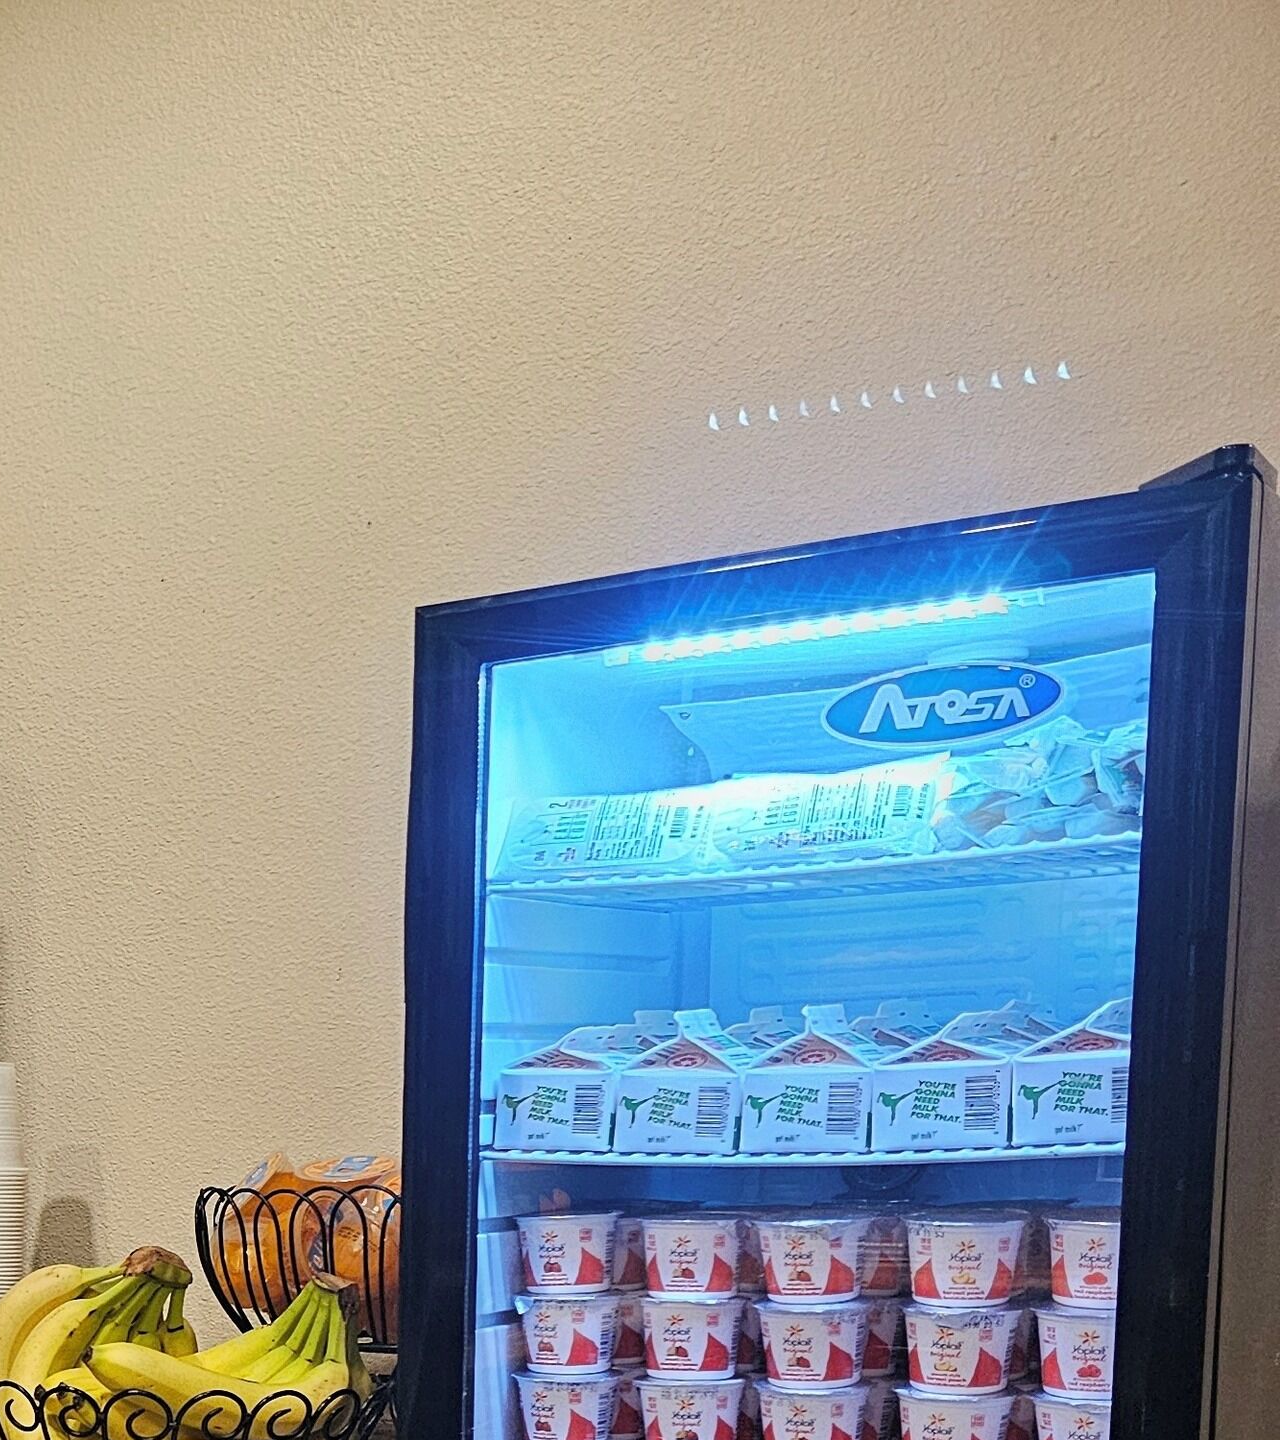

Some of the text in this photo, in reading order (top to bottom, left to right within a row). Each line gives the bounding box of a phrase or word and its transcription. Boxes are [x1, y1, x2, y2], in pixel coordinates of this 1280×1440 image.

[1062, 1072, 1103, 1082] YOU'RE
[919, 1080, 957, 1090] YOU'RE
[1058, 1080, 1102, 1090] GONNA
[915, 1088, 955, 1098] GONNA
[1056, 1088, 1085, 1096] NEED
[914, 1096, 940, 1104] NEED
[1055, 1096, 1084, 1106] MILK
[912, 1104, 939, 1113] MILK
[1054, 1104, 1108, 1116] FOR THAT.
[910, 1111, 962, 1124] FOR THAT.
[949, 1253, 984, 1262] Yoplait
[1079, 1252, 1115, 1263] Yoplait
[1072, 1345, 1108, 1356] Yoplait
[1068, 1431, 1103, 1440] Yoplait
